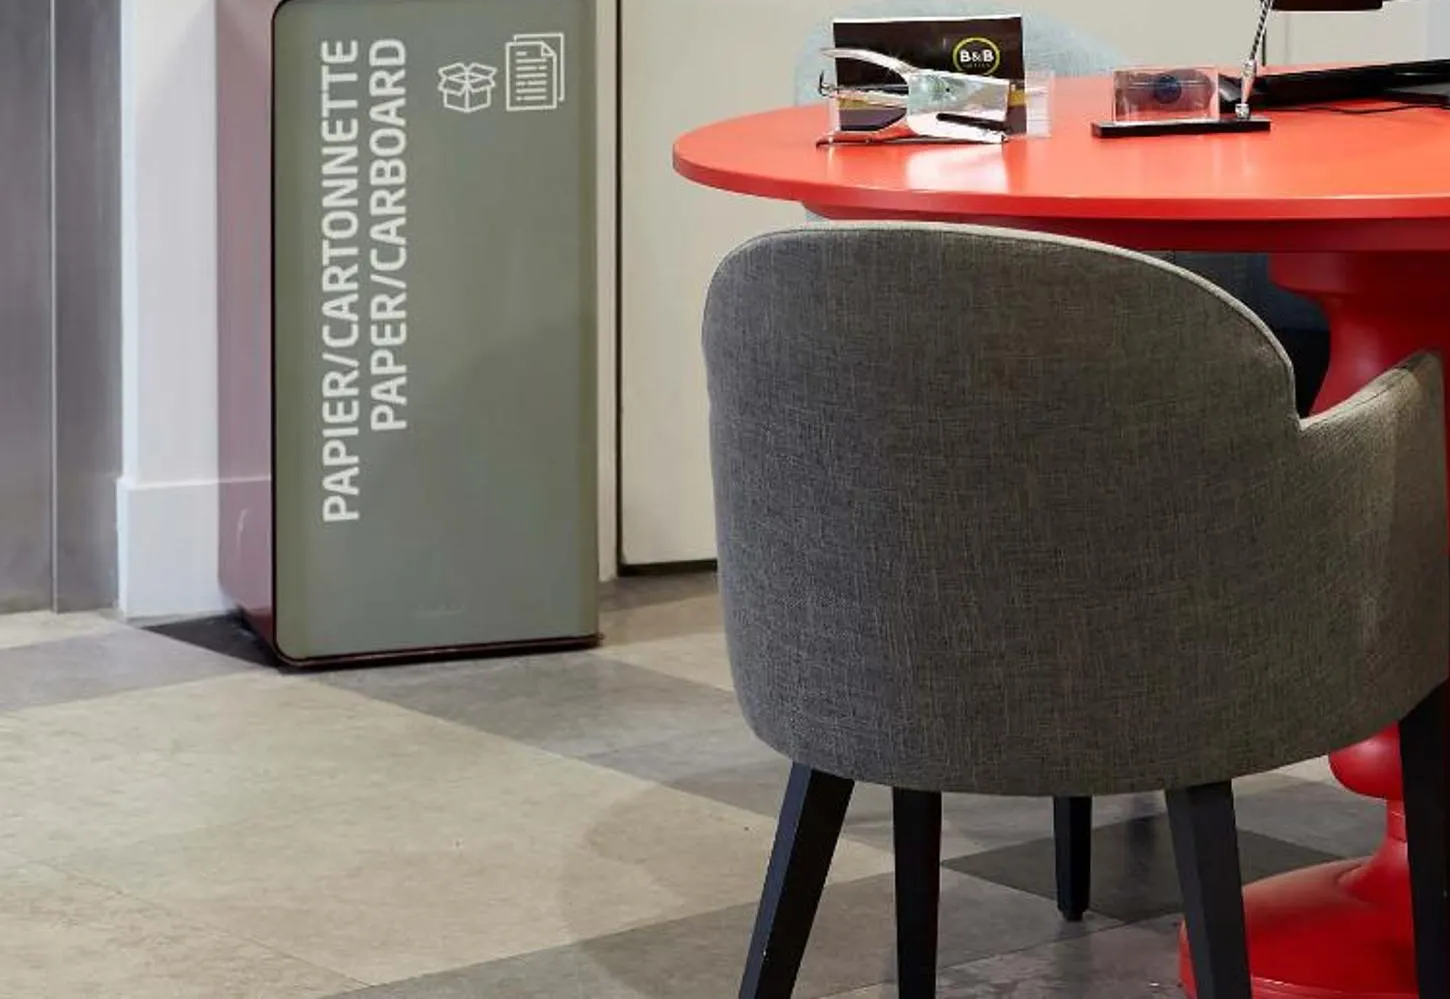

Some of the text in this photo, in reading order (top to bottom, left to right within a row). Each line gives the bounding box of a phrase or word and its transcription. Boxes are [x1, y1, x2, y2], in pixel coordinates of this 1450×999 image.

[367, 37, 408, 432] PAPER/CARBOARD
[959, 49, 994, 63] B&B
[321, 39, 360, 523] PAPIER/CARTONNETTE
